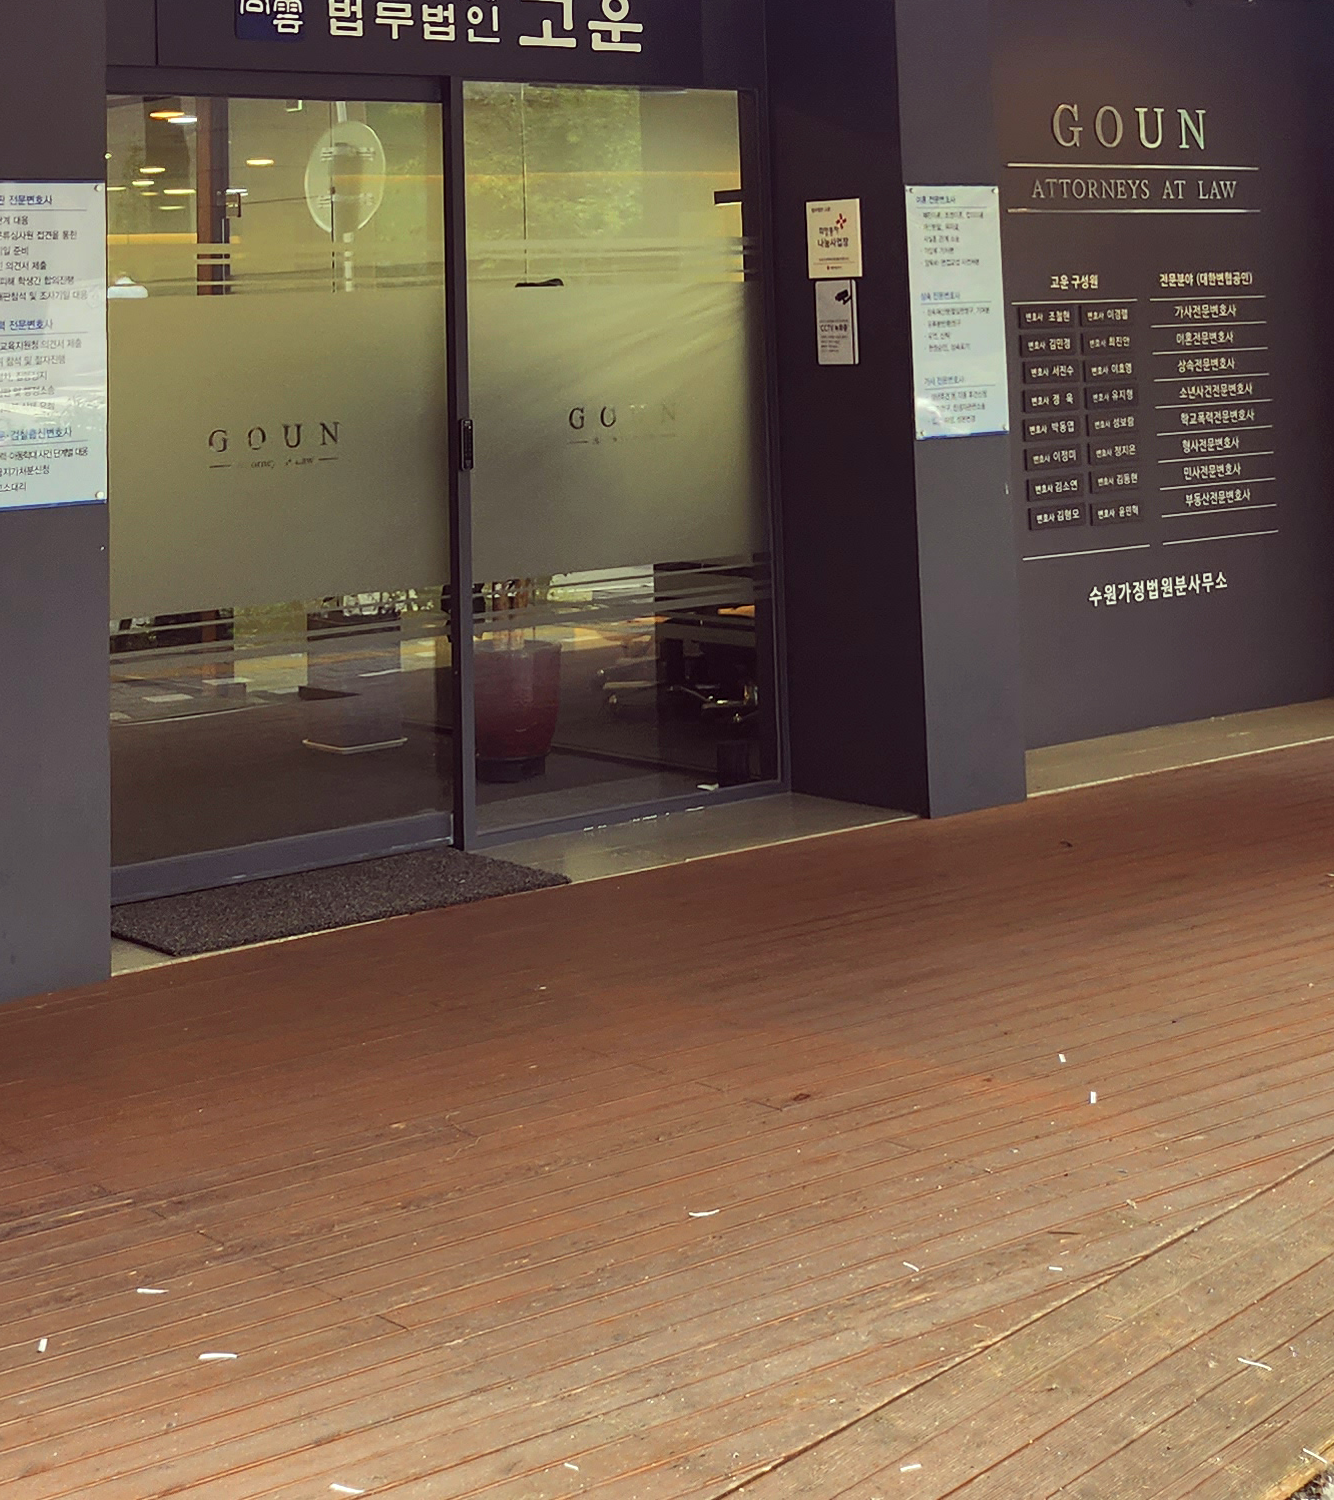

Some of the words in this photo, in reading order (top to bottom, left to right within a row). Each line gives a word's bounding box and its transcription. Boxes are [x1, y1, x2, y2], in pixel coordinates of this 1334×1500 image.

[1051, 103, 1207, 150] GOUN
[1031, 178, 1150, 200] ATTORNEYS
[1162, 180, 1186, 200] AT
[1198, 180, 1237, 200] LAW
[1050, 275, 1069, 290] 고운
[1071, 275, 1099, 290] 구성원
[1159, 273, 1194, 288] 전문분야
[1025, 312, 1043, 322] 변호사
[1087, 311, 1104, 321] 변호사
[1174, 303, 1237, 319] 가사전문변호사
[1089, 338, 1106, 349] 변호사
[1176, 330, 1234, 346] 이혼전문변호사
[1027, 340, 1046, 351] 변호사
[1091, 366, 1109, 376] 변호사
[1177, 357, 1236, 373] 상속전문변호사
[1030, 367, 1049, 378] 변호사
[1178, 382, 1254, 399] 소년사건전문변호사
[1031, 396, 1049, 407] 변호사
[1092, 392, 1110, 403] 변호사
[1180, 407, 1255, 426] 학교폭력전문변호사
[1029, 424, 1048, 436] 변호사
[1094, 420, 1111, 430] 변호사
[208, 422, 340, 453] GOUN
[1182, 436, 1240, 454] 형사전문변호사
[1032, 453, 1051, 465] 변호사
[1095, 448, 1112, 458] 변호사
[1183, 462, 1242, 481] 민사전문변호사
[1097, 476, 1114, 486] 변호사
[1034, 484, 1054, 495] 변호사
[1185, 488, 1251, 507] 부동산전문변호사
[1036, 513, 1055, 524] 변호사
[1097, 508, 1115, 520] 변호사
[1088, 571, 1228, 607] 수원가정법원분사무소
